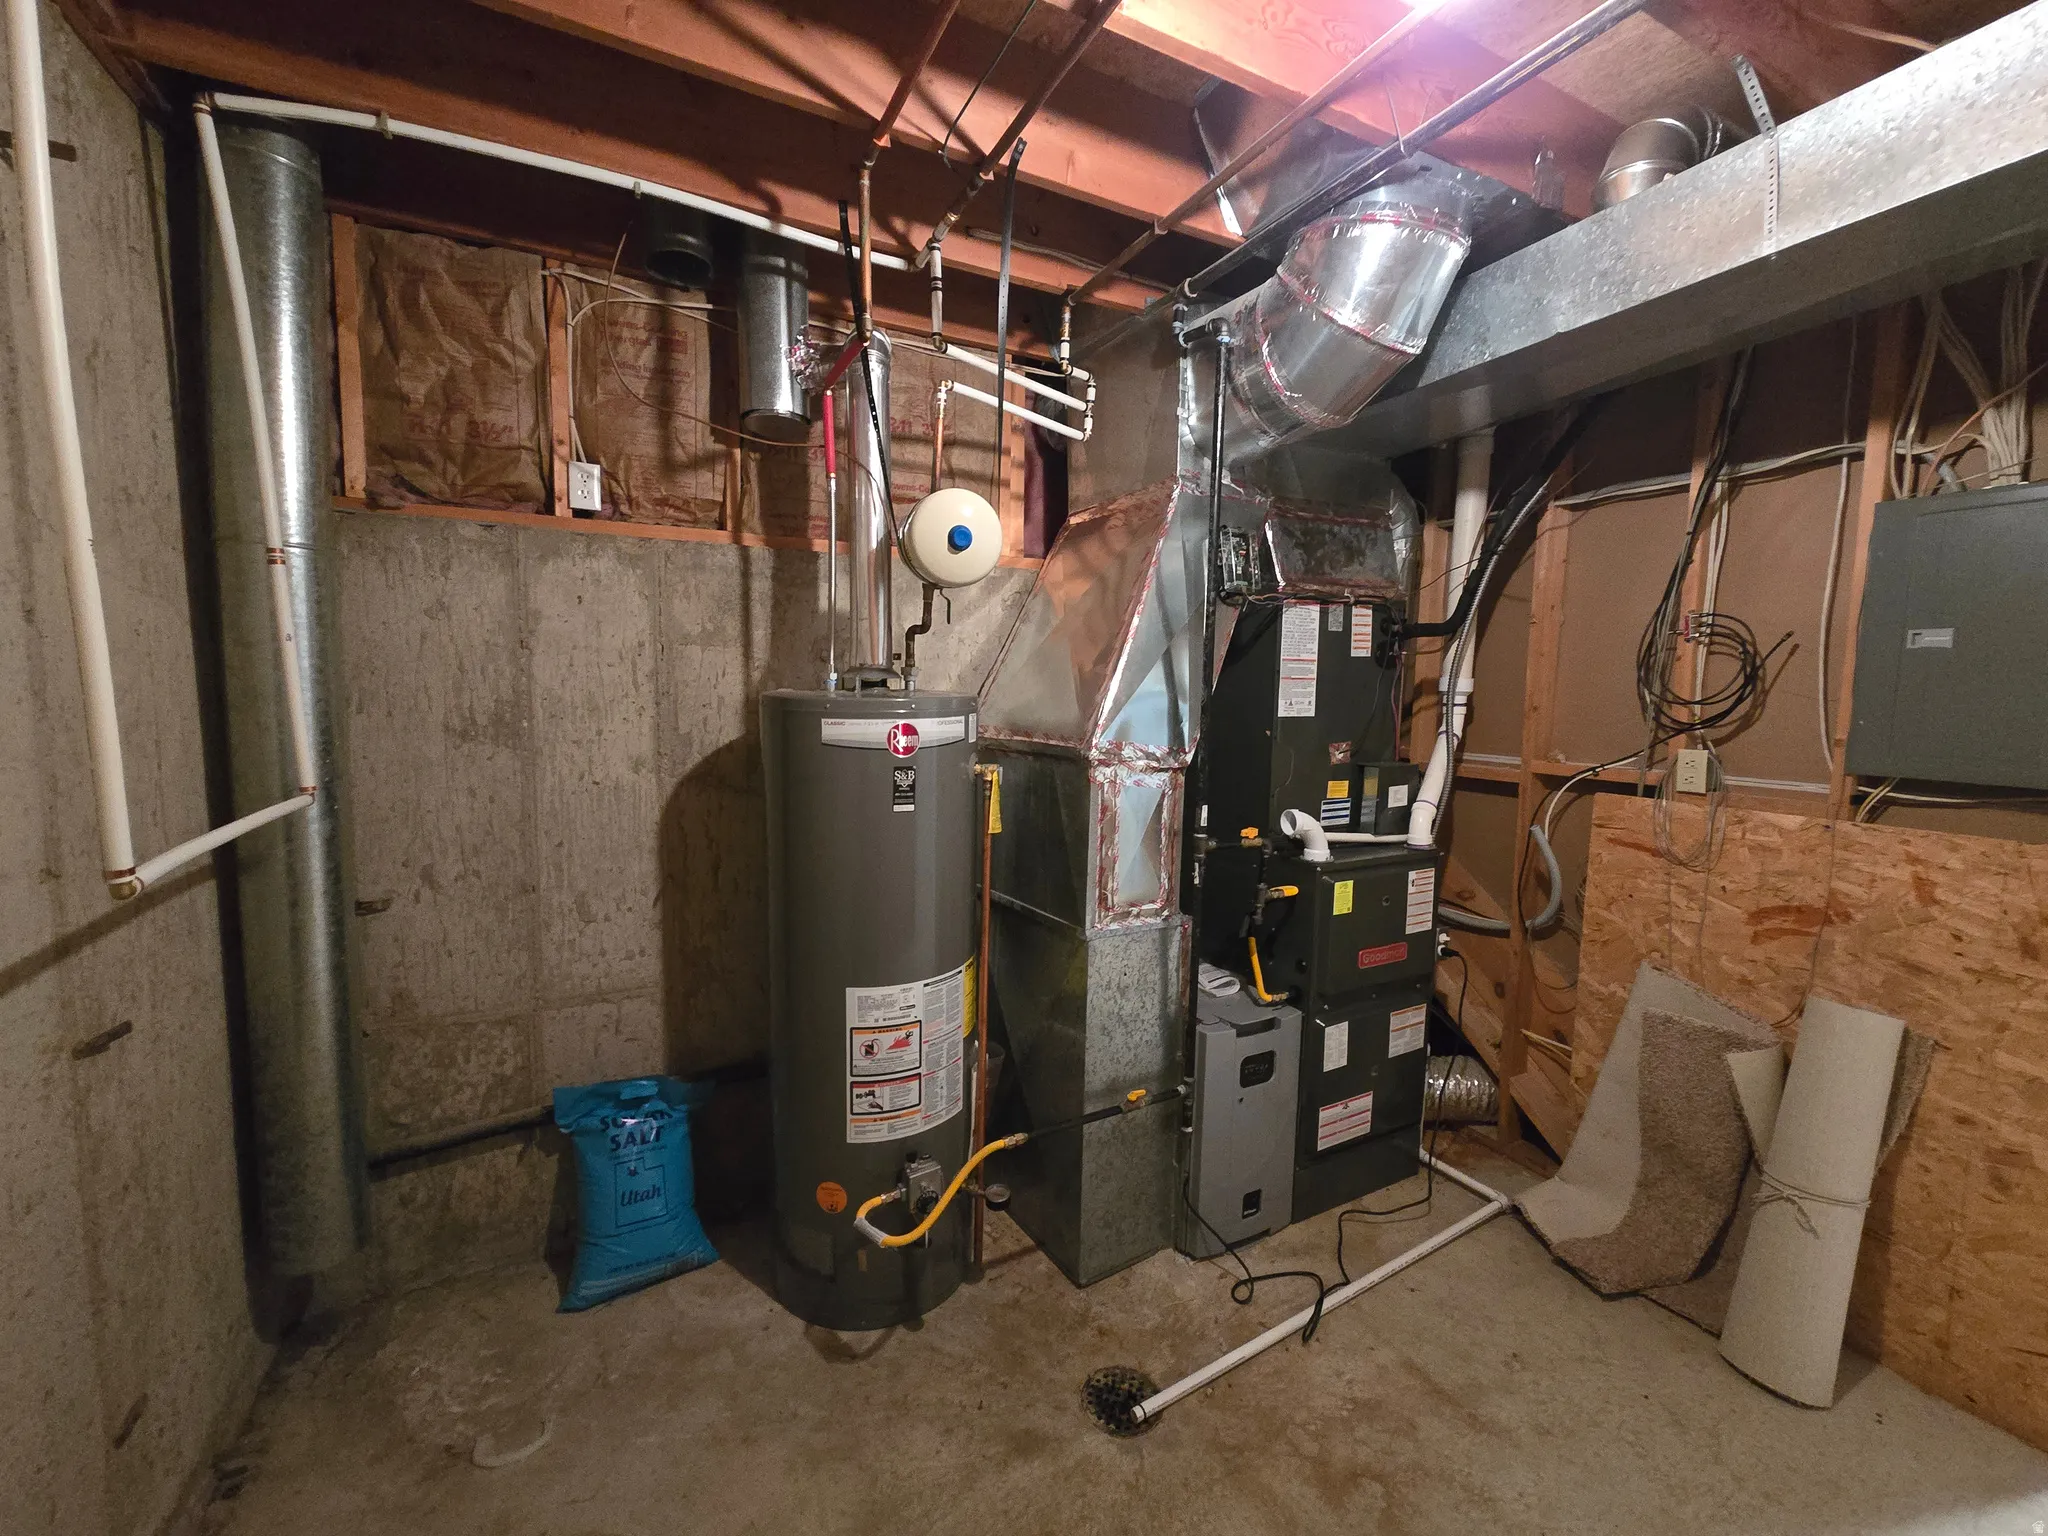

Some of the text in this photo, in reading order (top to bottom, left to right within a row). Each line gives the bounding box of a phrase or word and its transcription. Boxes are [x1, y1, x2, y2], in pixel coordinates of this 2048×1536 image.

[891, 728, 919, 752] Rheem
[894, 769, 915, 780] S&B
[609, 1126, 664, 1151] SALT
[620, 1184, 661, 1208] Utah
